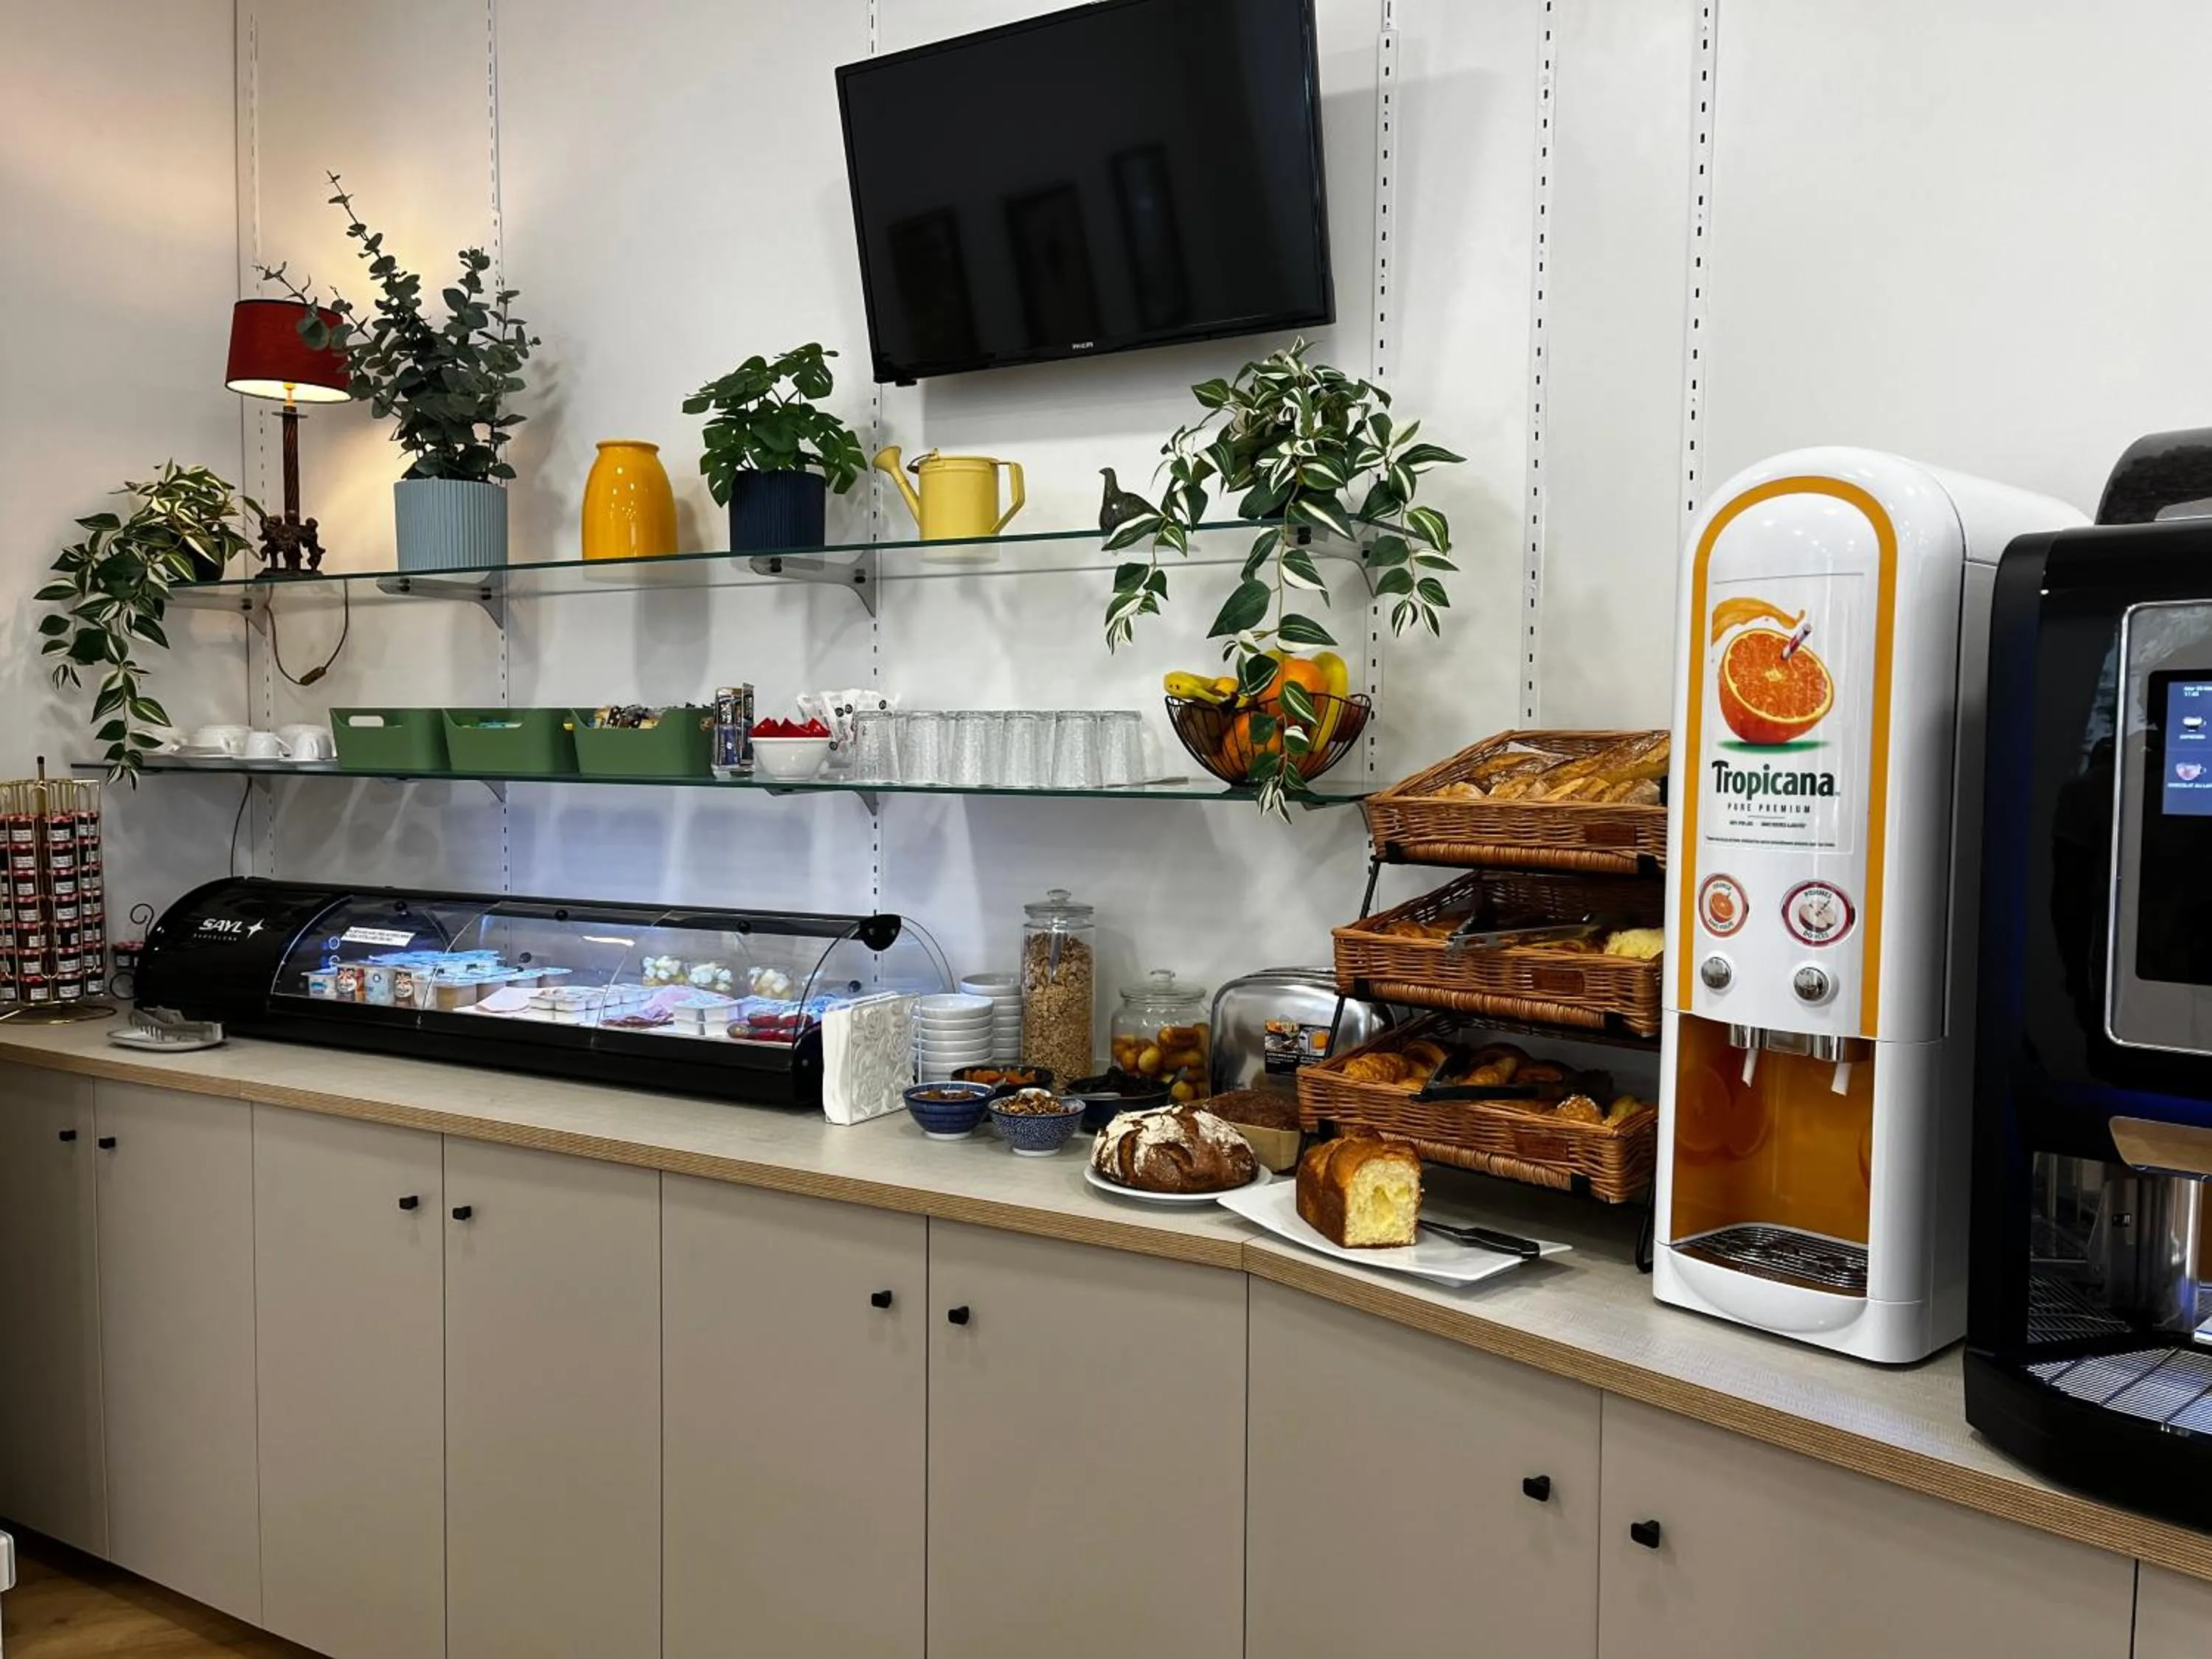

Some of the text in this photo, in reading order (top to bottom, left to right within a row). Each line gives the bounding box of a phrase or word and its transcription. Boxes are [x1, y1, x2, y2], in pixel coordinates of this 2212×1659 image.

[1711, 760, 1834, 801] Tropicana
[1728, 802, 1811, 813] PURE PREMIUM
[198, 918, 243, 933] SAYL
